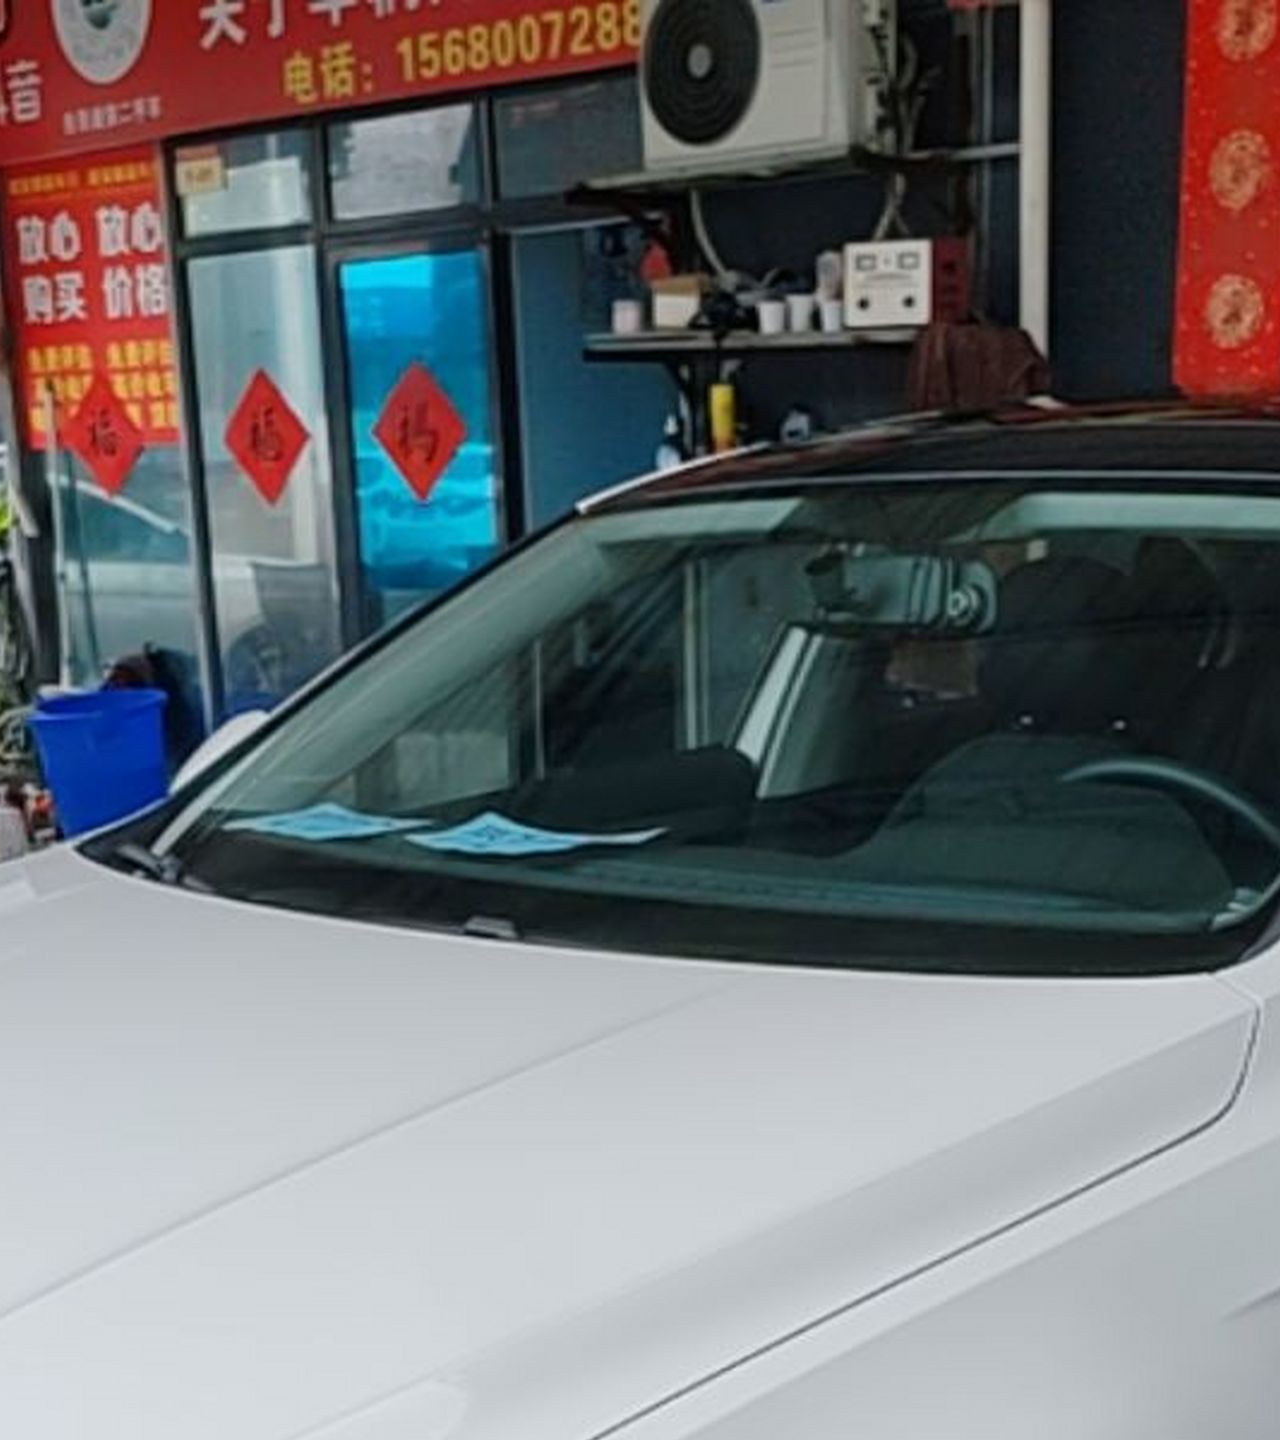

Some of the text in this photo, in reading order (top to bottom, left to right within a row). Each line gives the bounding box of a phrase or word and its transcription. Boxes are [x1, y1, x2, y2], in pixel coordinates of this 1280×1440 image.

[16, 210, 81, 265] 放心
[95, 201, 162, 259] 放心
[22, 270, 88, 325] 购买
[102, 262, 168, 320] 价格
